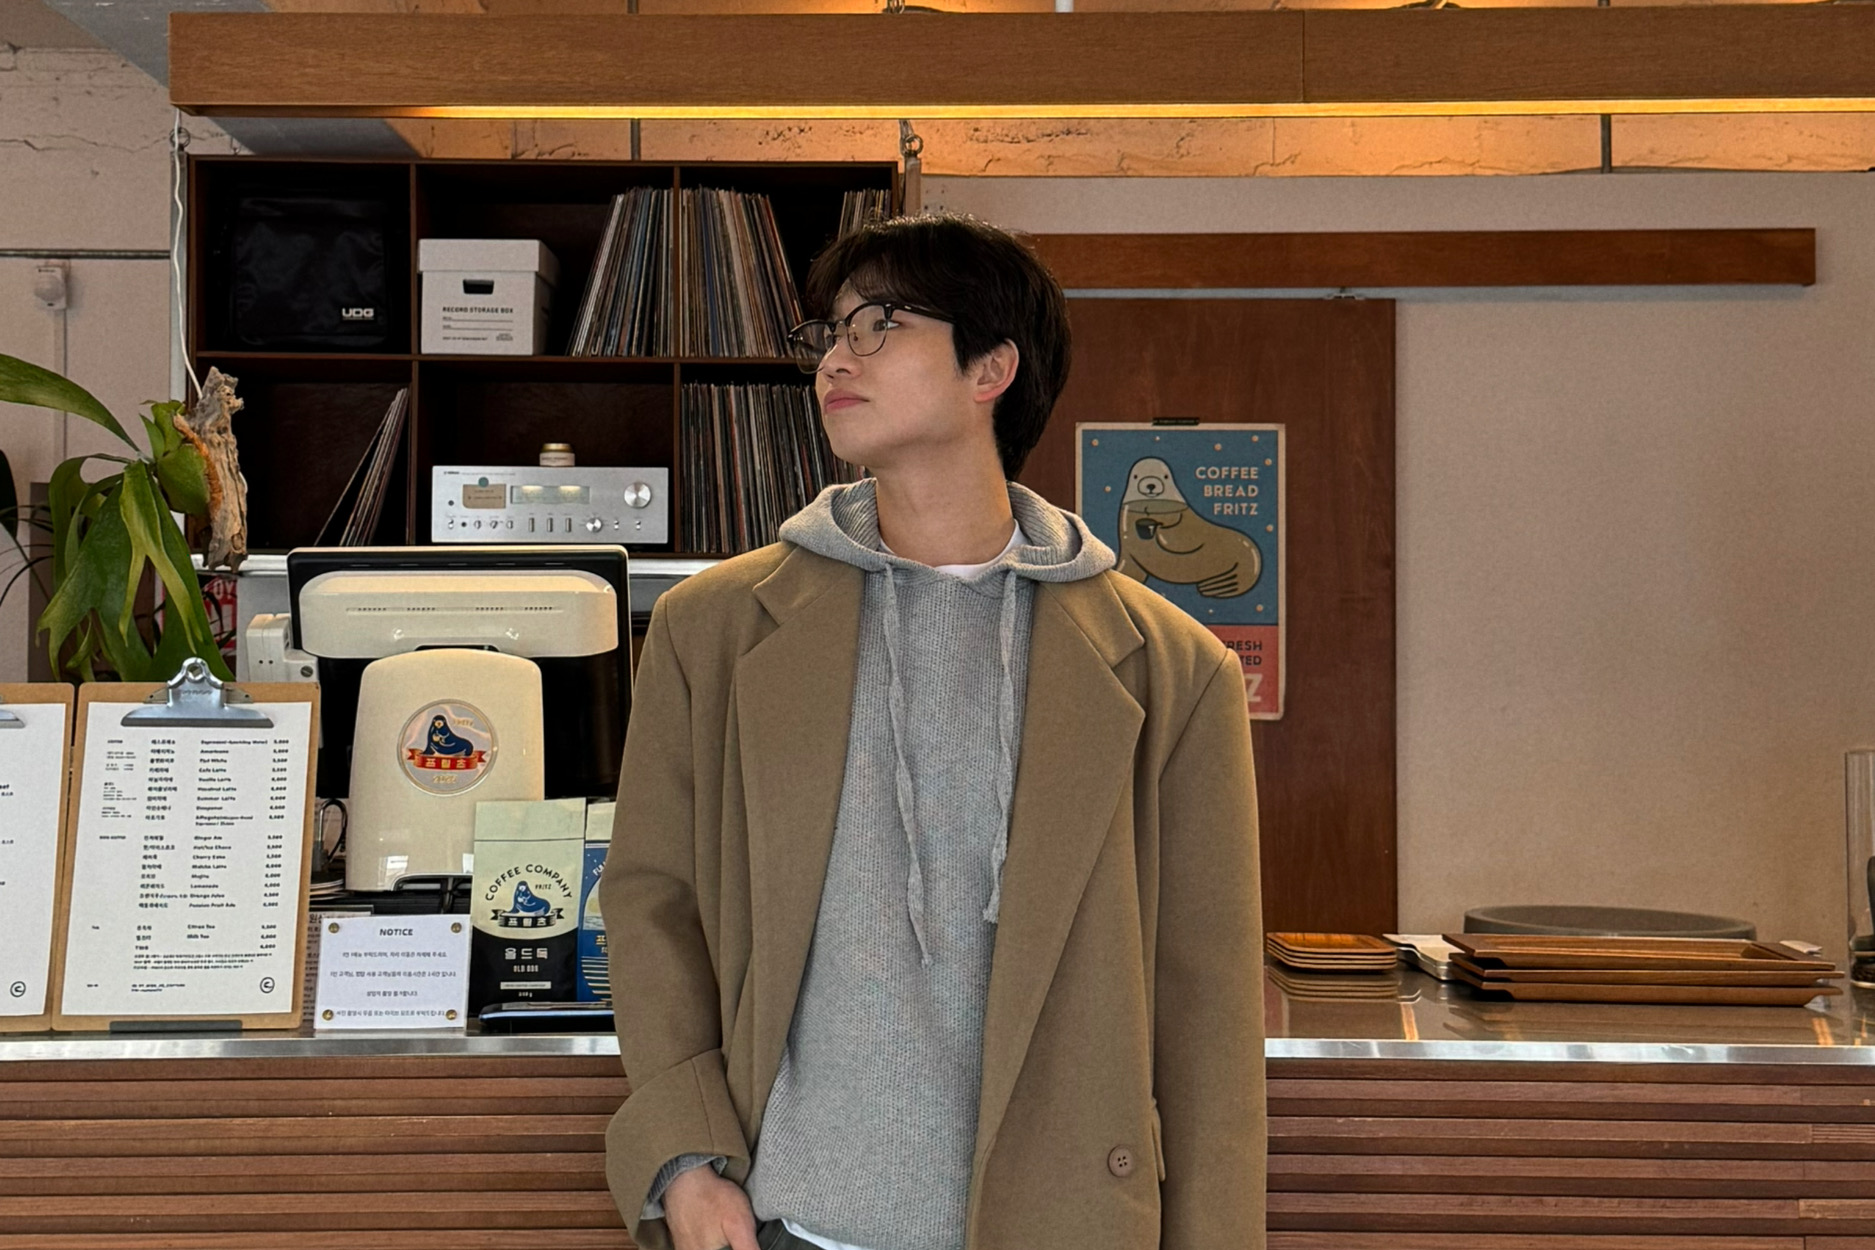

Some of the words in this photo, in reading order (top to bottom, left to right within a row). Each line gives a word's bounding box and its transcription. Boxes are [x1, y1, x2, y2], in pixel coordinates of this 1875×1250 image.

[342, 308, 374, 317] UDG
[1195, 466, 1259, 479] COFFEE
[1204, 485, 1259, 497] BREAD
[1214, 503, 1258, 515] FRITZ
[485, 866, 521, 901] COFFEE
[526, 864, 572, 898] COMPANY
